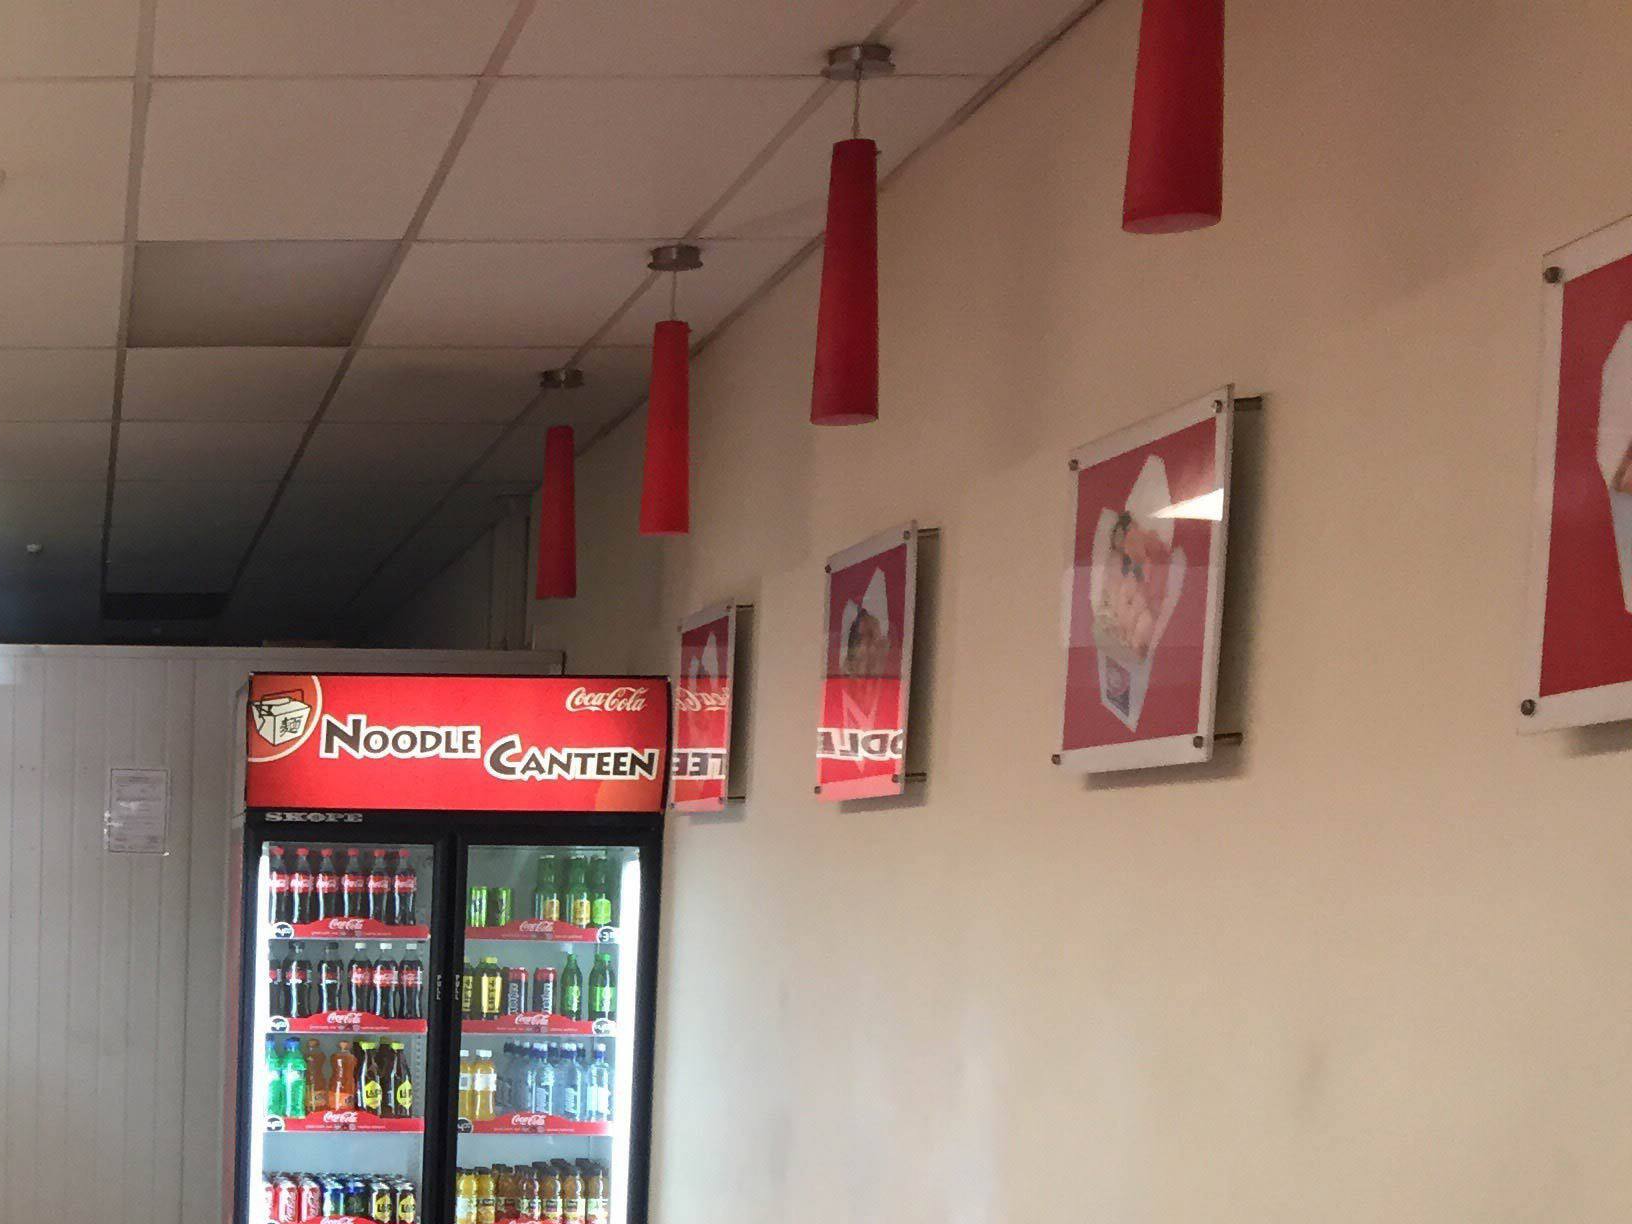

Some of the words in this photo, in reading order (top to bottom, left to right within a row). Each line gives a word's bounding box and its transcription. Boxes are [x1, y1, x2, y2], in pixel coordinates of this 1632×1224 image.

[565, 686, 648, 713] Coca-Cola
[322, 716, 480, 756] NOODLE
[488, 736, 657, 779] CANTEEN
[264, 811, 364, 823] SKOPE
